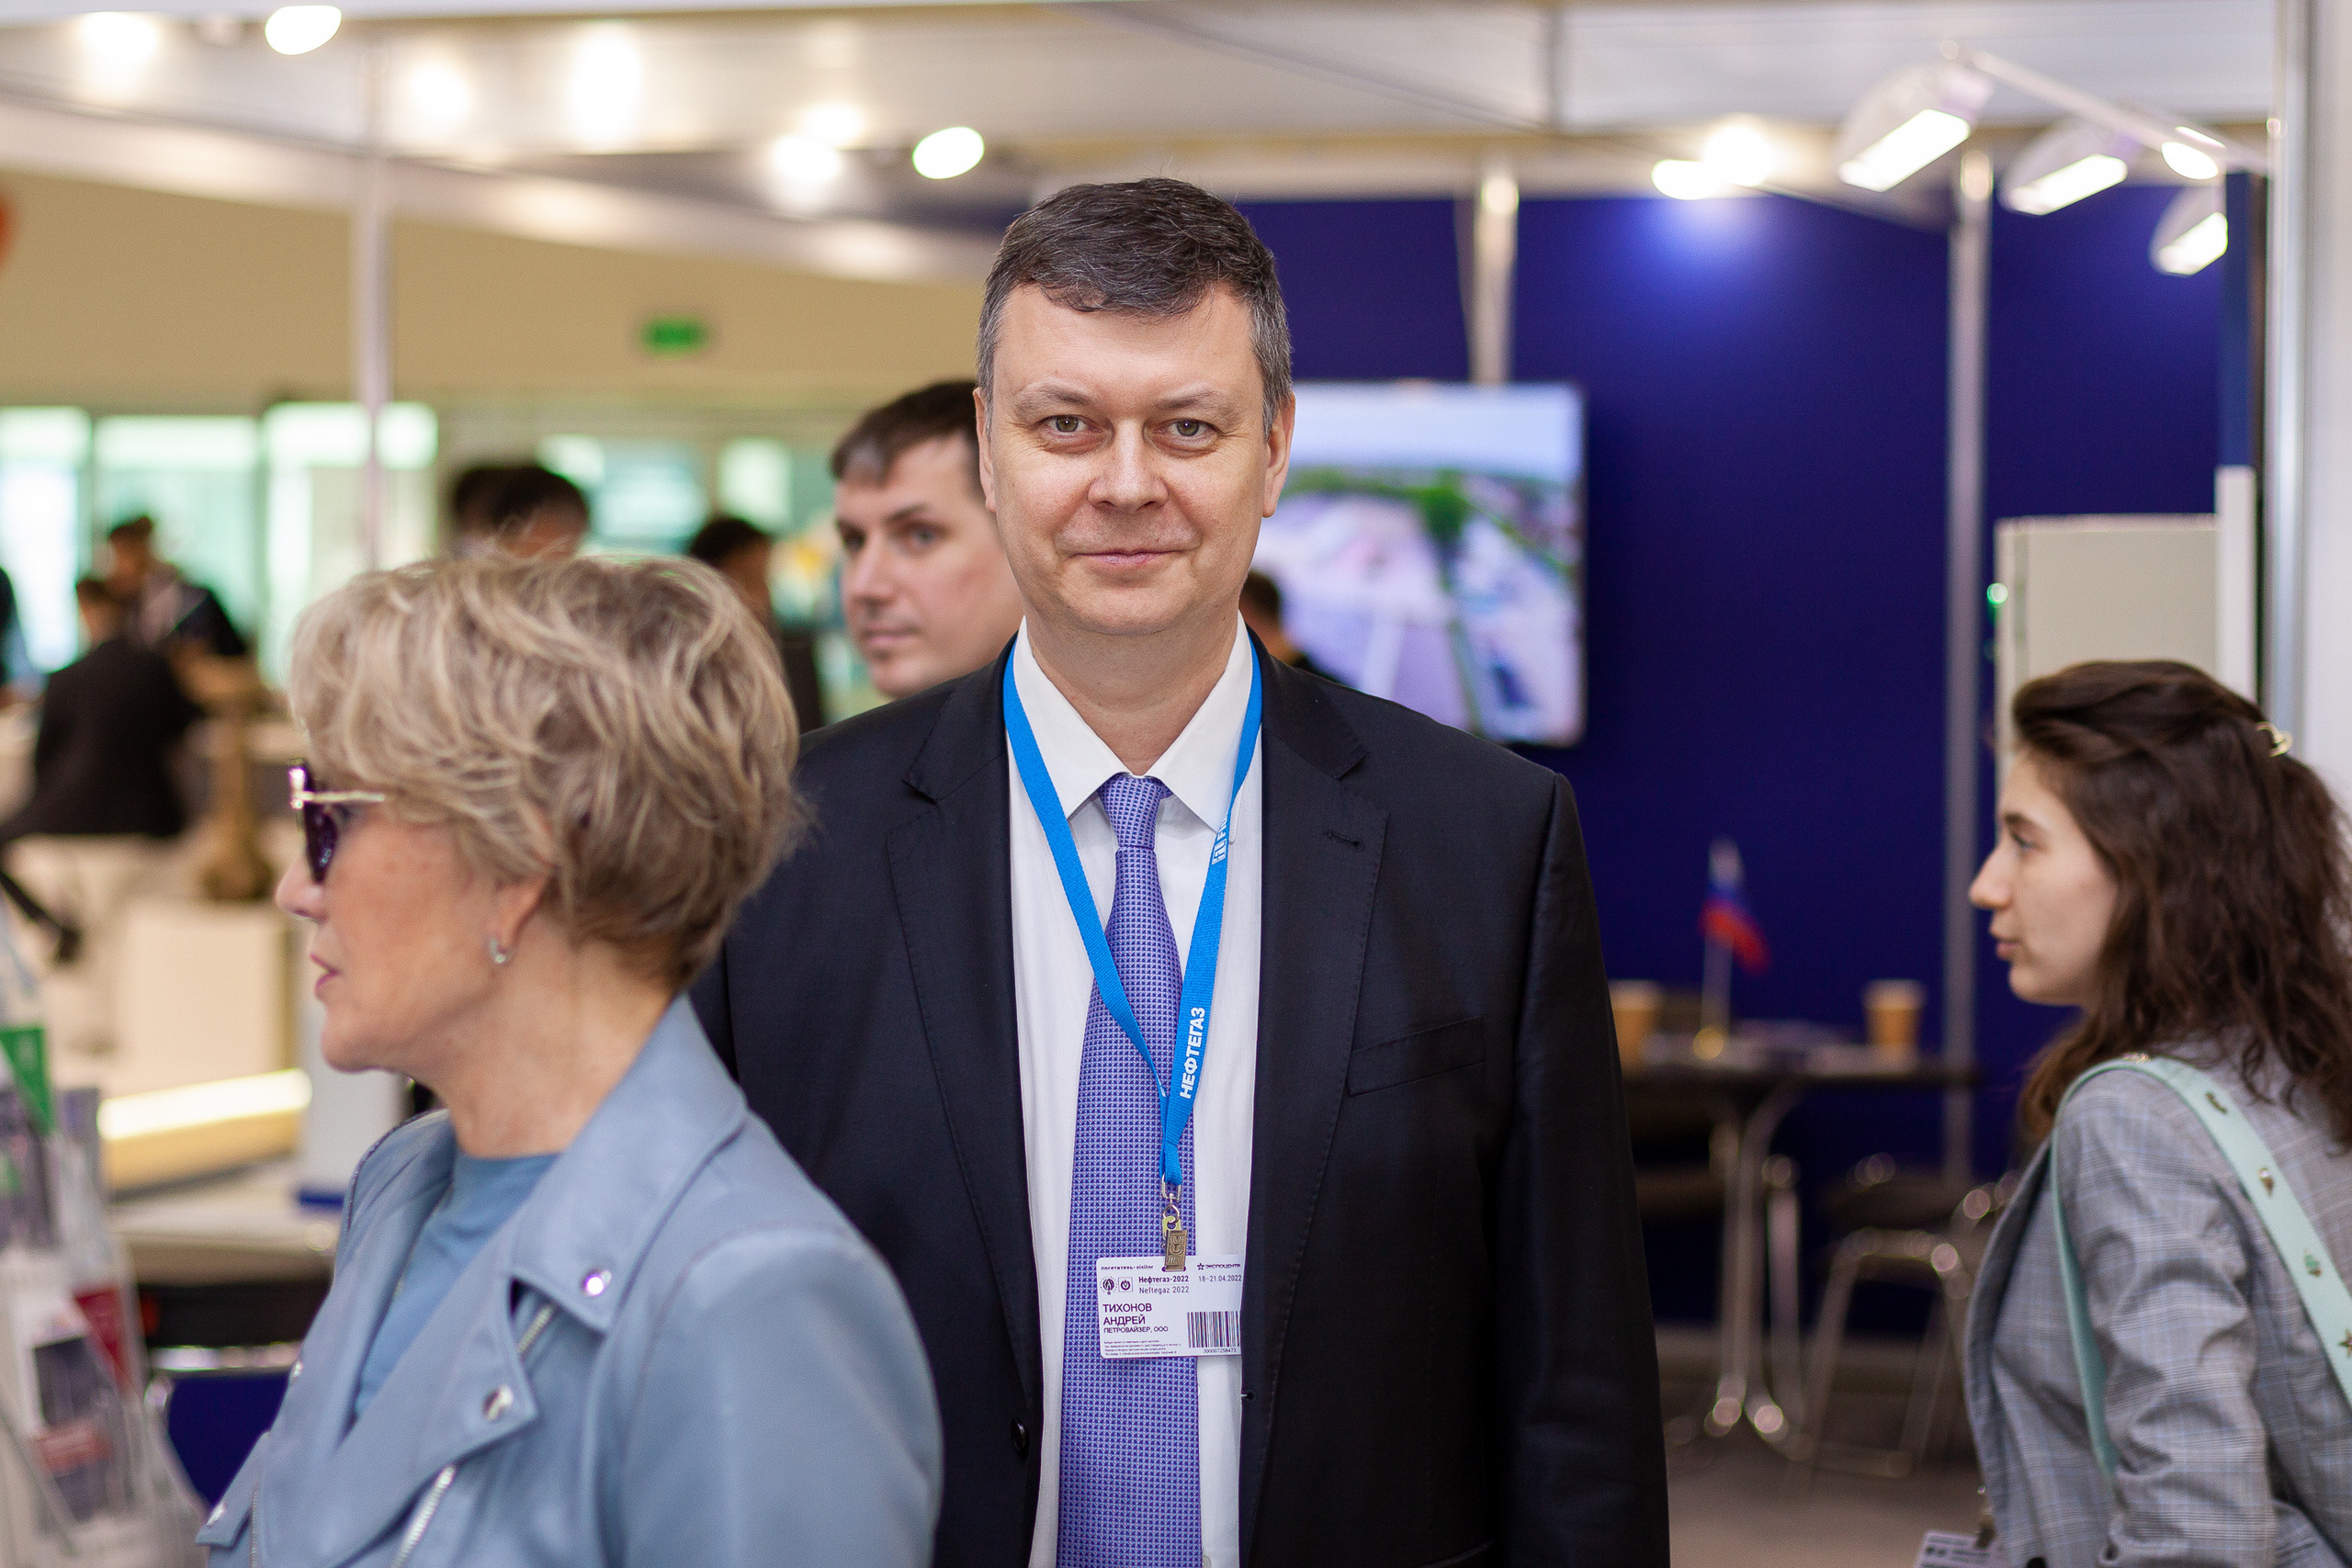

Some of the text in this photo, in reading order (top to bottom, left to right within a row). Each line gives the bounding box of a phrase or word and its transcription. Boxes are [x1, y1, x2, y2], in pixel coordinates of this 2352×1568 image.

[1179, 1007, 1205, 1100] НЕФТЕГАЗ
[1138, 1275, 1189, 1284] Нефтегаз-2022
[1139, 1285, 1190, 1295] Neftegaz 2022
[1102, 1303, 1152, 1313] ТИХОНОВ
[1103, 1314, 1146, 1326] АНДРЕЙ
[1103, 1325, 1152, 1334] ПЕТРОВАЙЗЕР,
